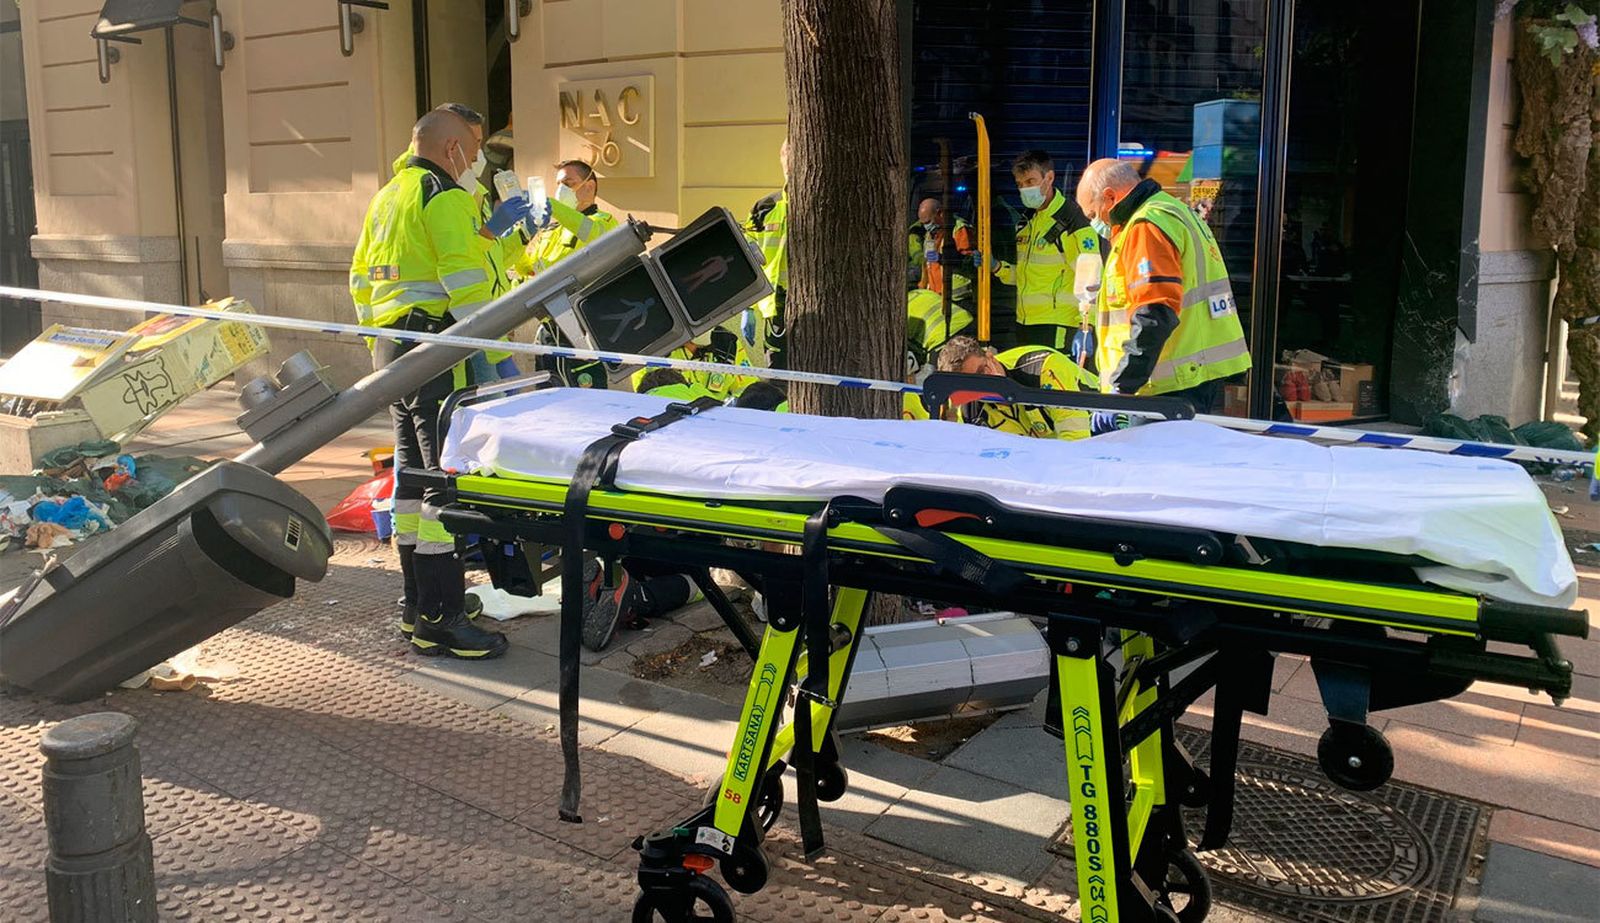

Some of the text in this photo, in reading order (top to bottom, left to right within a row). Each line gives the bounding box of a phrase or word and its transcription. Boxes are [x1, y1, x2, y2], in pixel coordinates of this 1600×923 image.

[560, 86, 640, 128] NAC
[735, 712, 761, 779] KARTSANA
[724, 788, 741, 804] 58
[1080, 764, 1103, 872] TG 880S
[1090, 885, 1105, 902] C4
